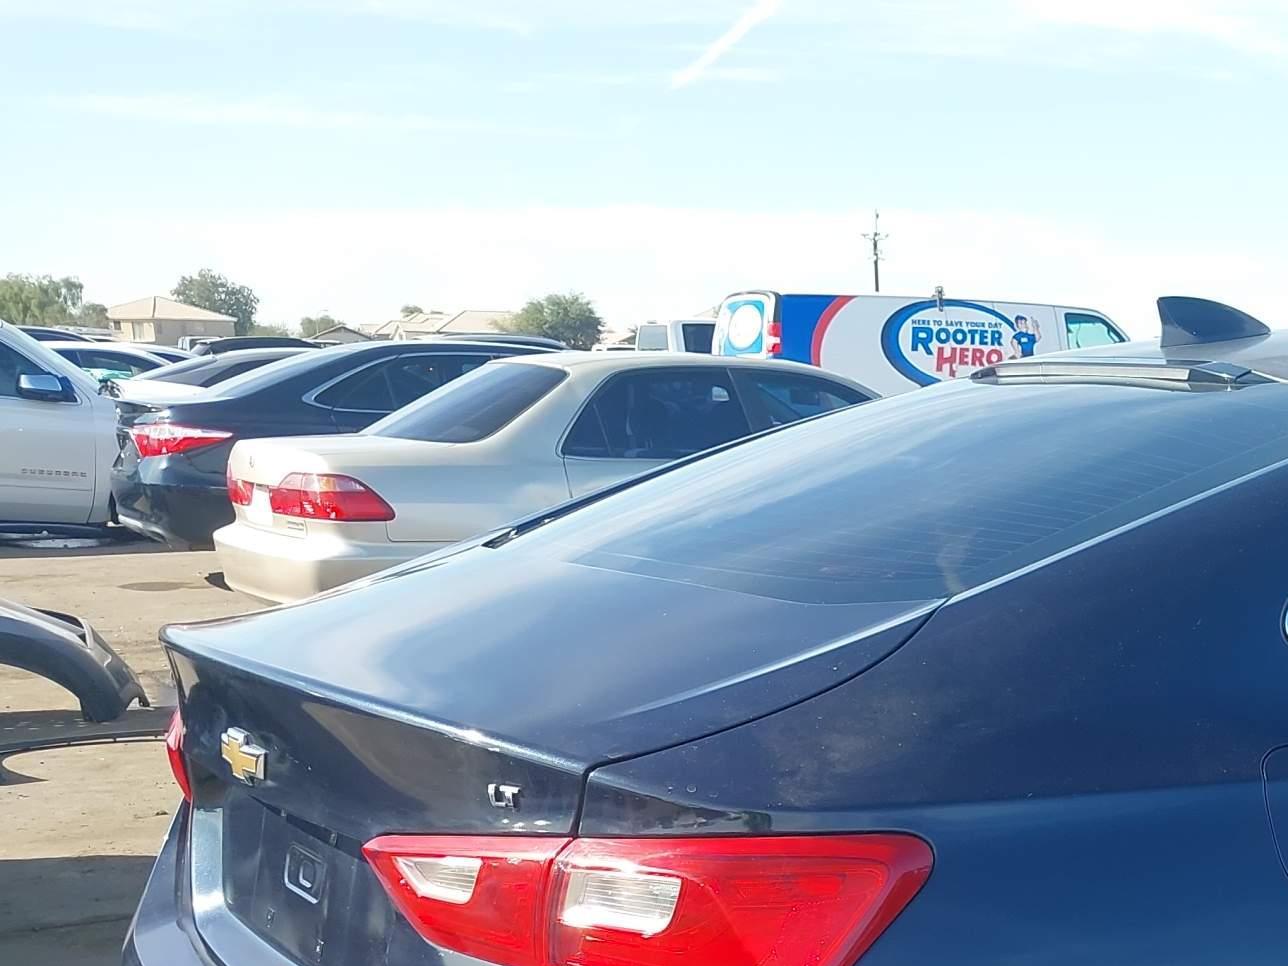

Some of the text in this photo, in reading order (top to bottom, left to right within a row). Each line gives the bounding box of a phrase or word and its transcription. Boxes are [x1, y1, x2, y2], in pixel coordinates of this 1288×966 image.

[933, 319, 943, 327] TO
[945, 320, 963, 328] SAVE
[965, 321, 986, 329] YOUR
[988, 321, 1003, 329] DAY
[911, 326, 1003, 355] ROOTER
[935, 346, 1003, 377] HERO
